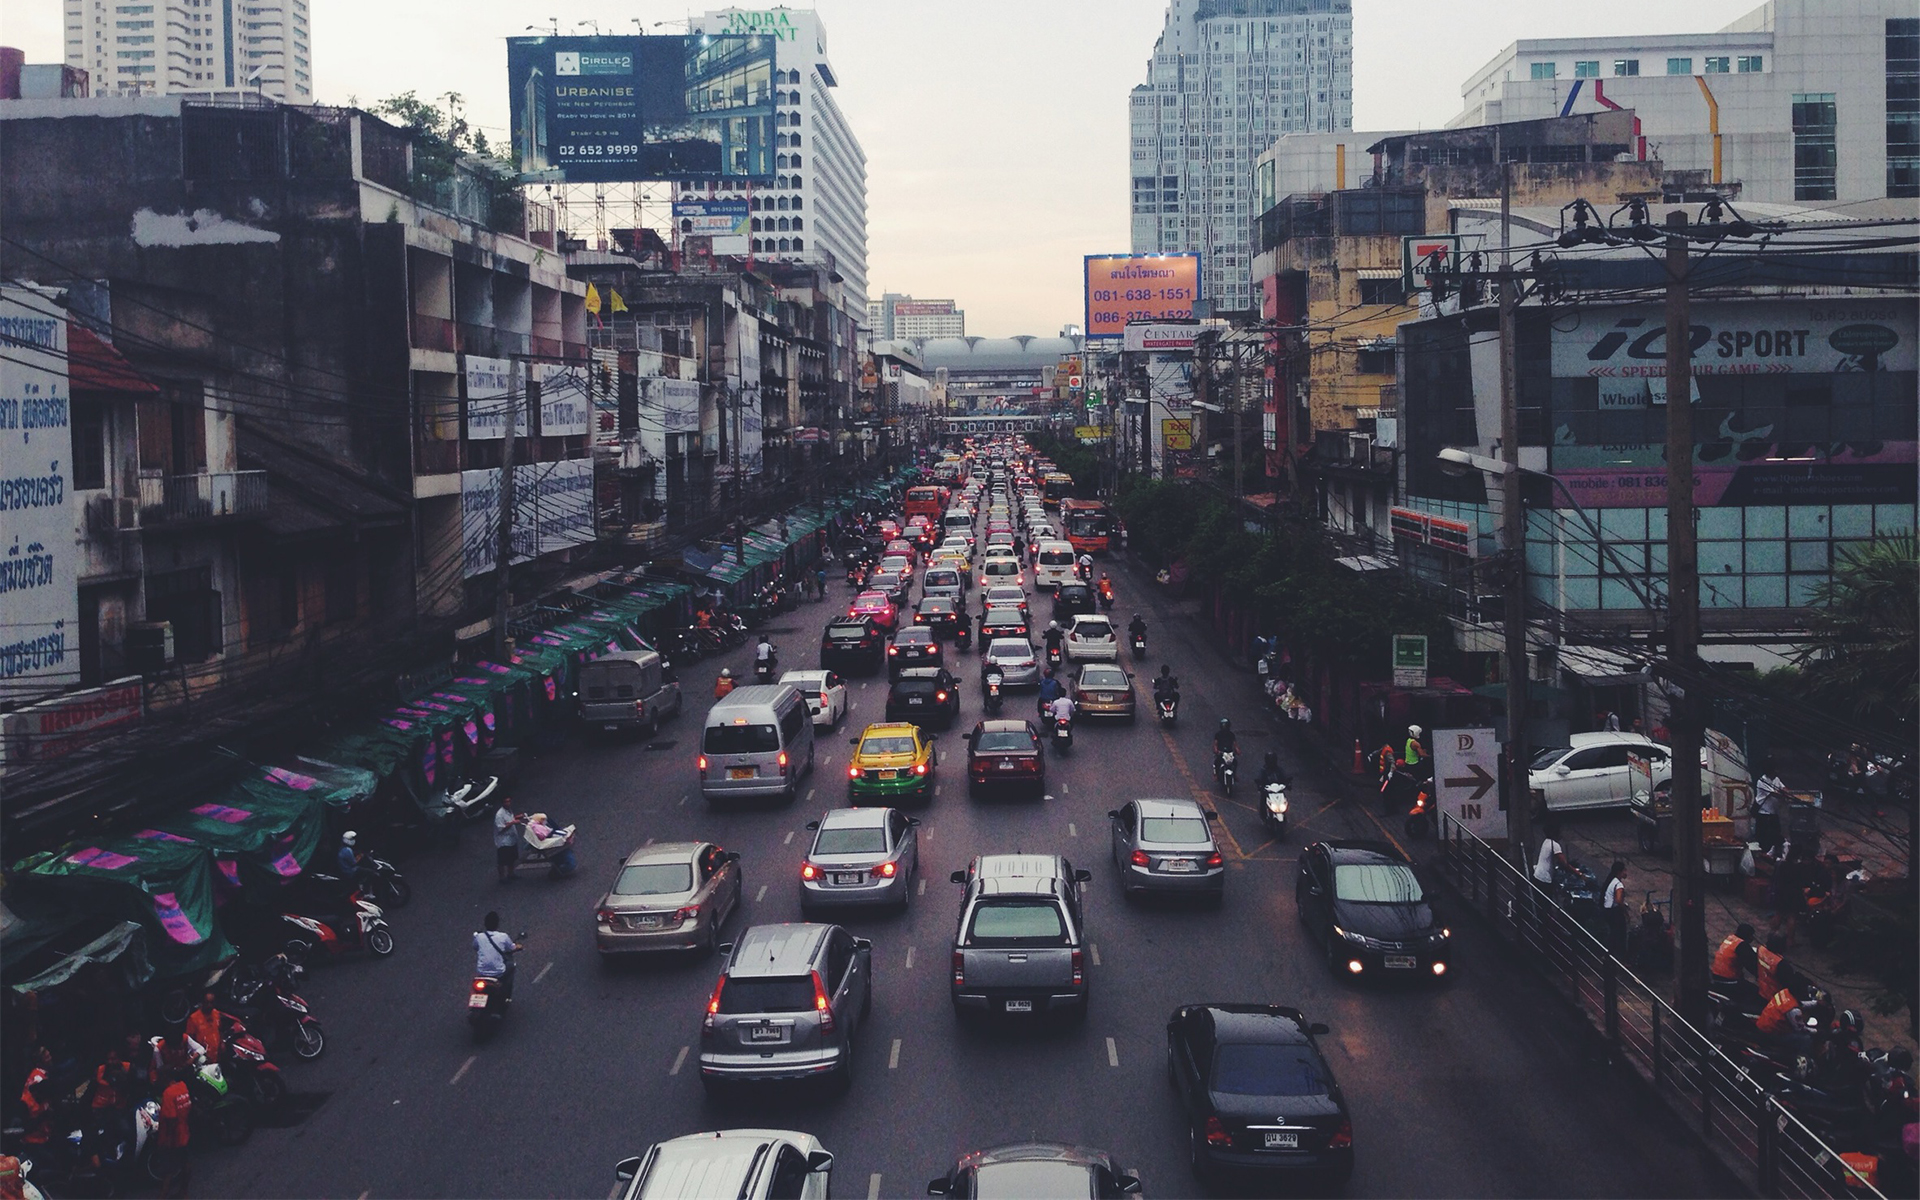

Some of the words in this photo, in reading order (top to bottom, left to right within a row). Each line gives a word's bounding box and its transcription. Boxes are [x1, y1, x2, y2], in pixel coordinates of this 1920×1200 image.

[728, 12, 790, 26] INDRA
[556, 86, 634, 96] URBANISE
[559, 145, 575, 155] 02
[579, 145, 603, 155] 652
[607, 145, 638, 155] 9999
[1094, 289, 1191, 301] 081-638-1551
[1717, 329, 1810, 357] SPORT
[1718, 363, 1761, 375] GAME
[1569, 477, 1609, 489] mobile
[1618, 476, 1641, 487] 081
[1461, 804, 1482, 819] IN
